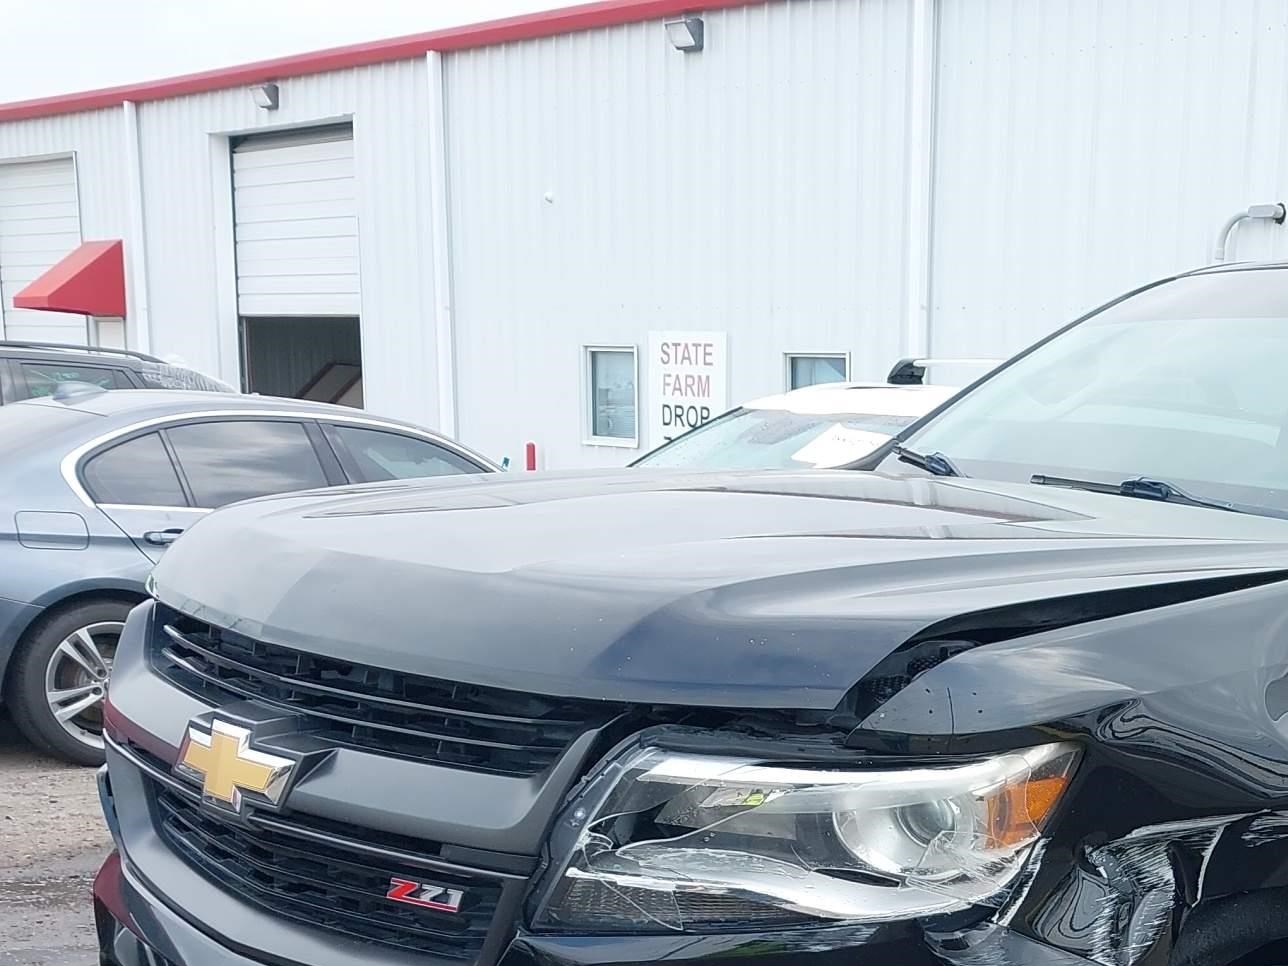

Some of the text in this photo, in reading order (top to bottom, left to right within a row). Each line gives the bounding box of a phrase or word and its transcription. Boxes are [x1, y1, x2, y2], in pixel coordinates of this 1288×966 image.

[660, 342, 714, 366] STATE
[662, 373, 711, 398] FARM
[662, 403, 711, 428] DROP
[386, 877, 464, 913] Z71
